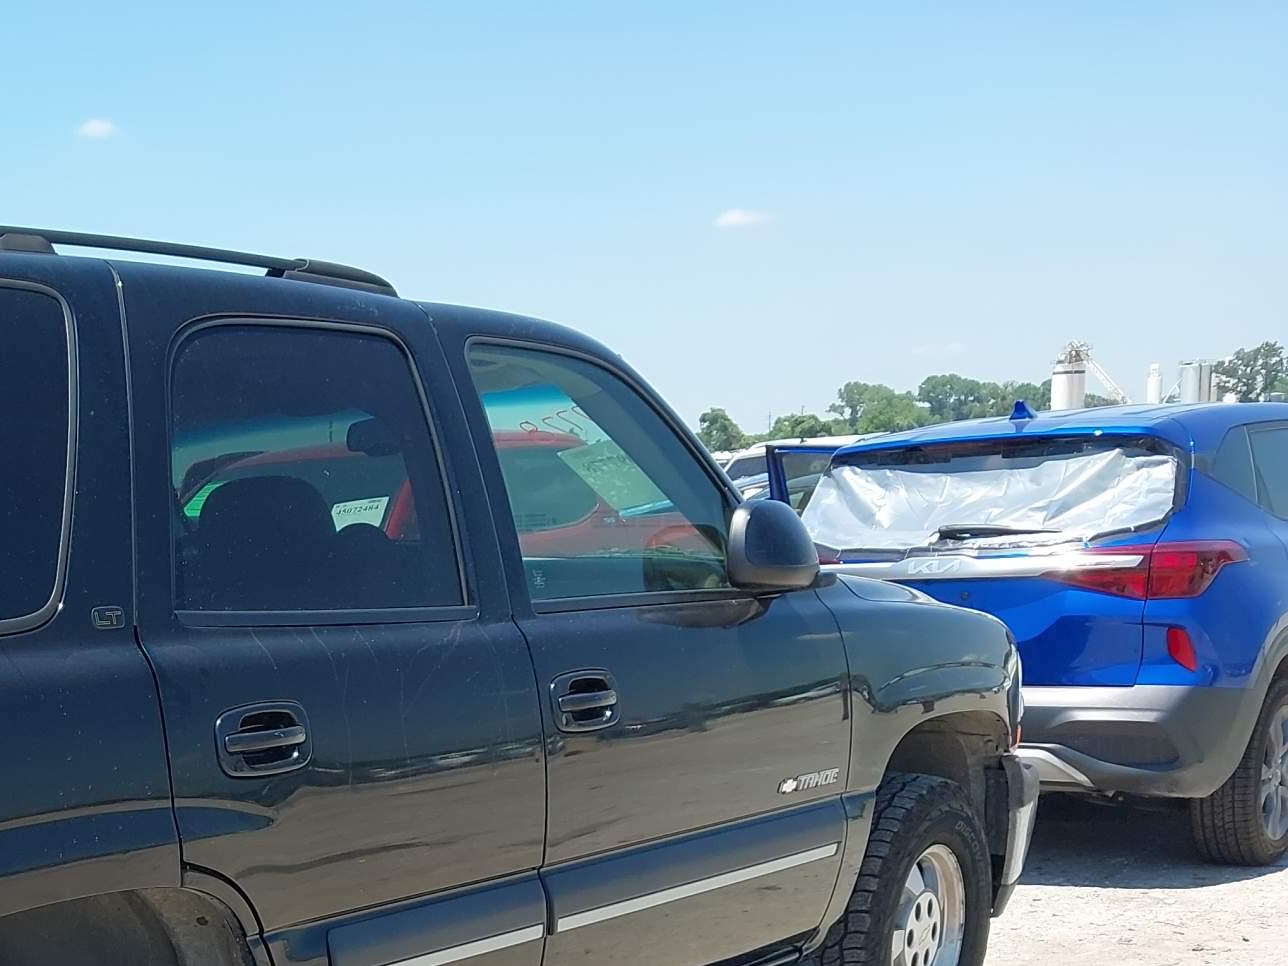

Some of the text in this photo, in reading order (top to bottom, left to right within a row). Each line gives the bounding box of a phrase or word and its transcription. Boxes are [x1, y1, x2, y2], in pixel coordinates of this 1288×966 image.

[908, 559, 962, 575] KIA
[94, 610, 121, 625] LT
[796, 768, 840, 790] TAHOE
